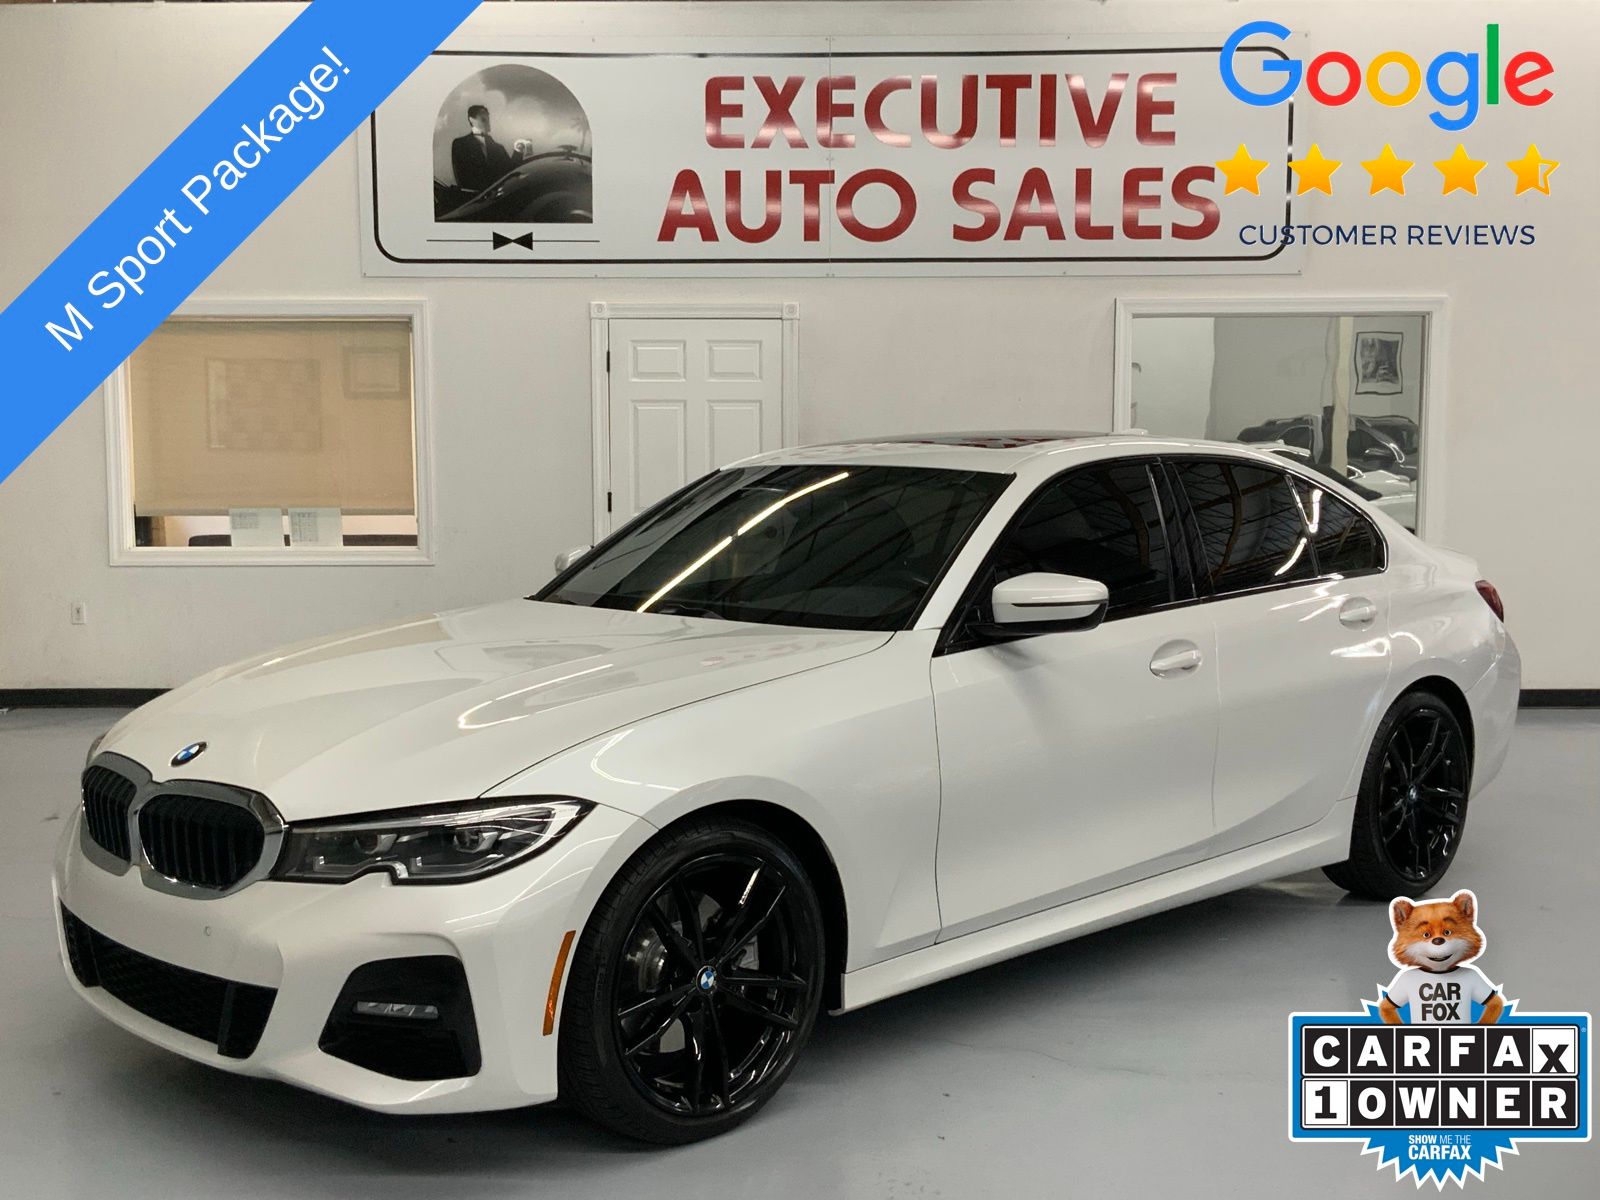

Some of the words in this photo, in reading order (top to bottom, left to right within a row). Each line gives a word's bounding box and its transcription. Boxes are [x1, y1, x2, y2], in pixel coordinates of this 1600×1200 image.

[705, 73, 1177, 149] EXECUTIVE
[657, 168, 917, 243] AUTO
[952, 165, 1221, 242] SALES
